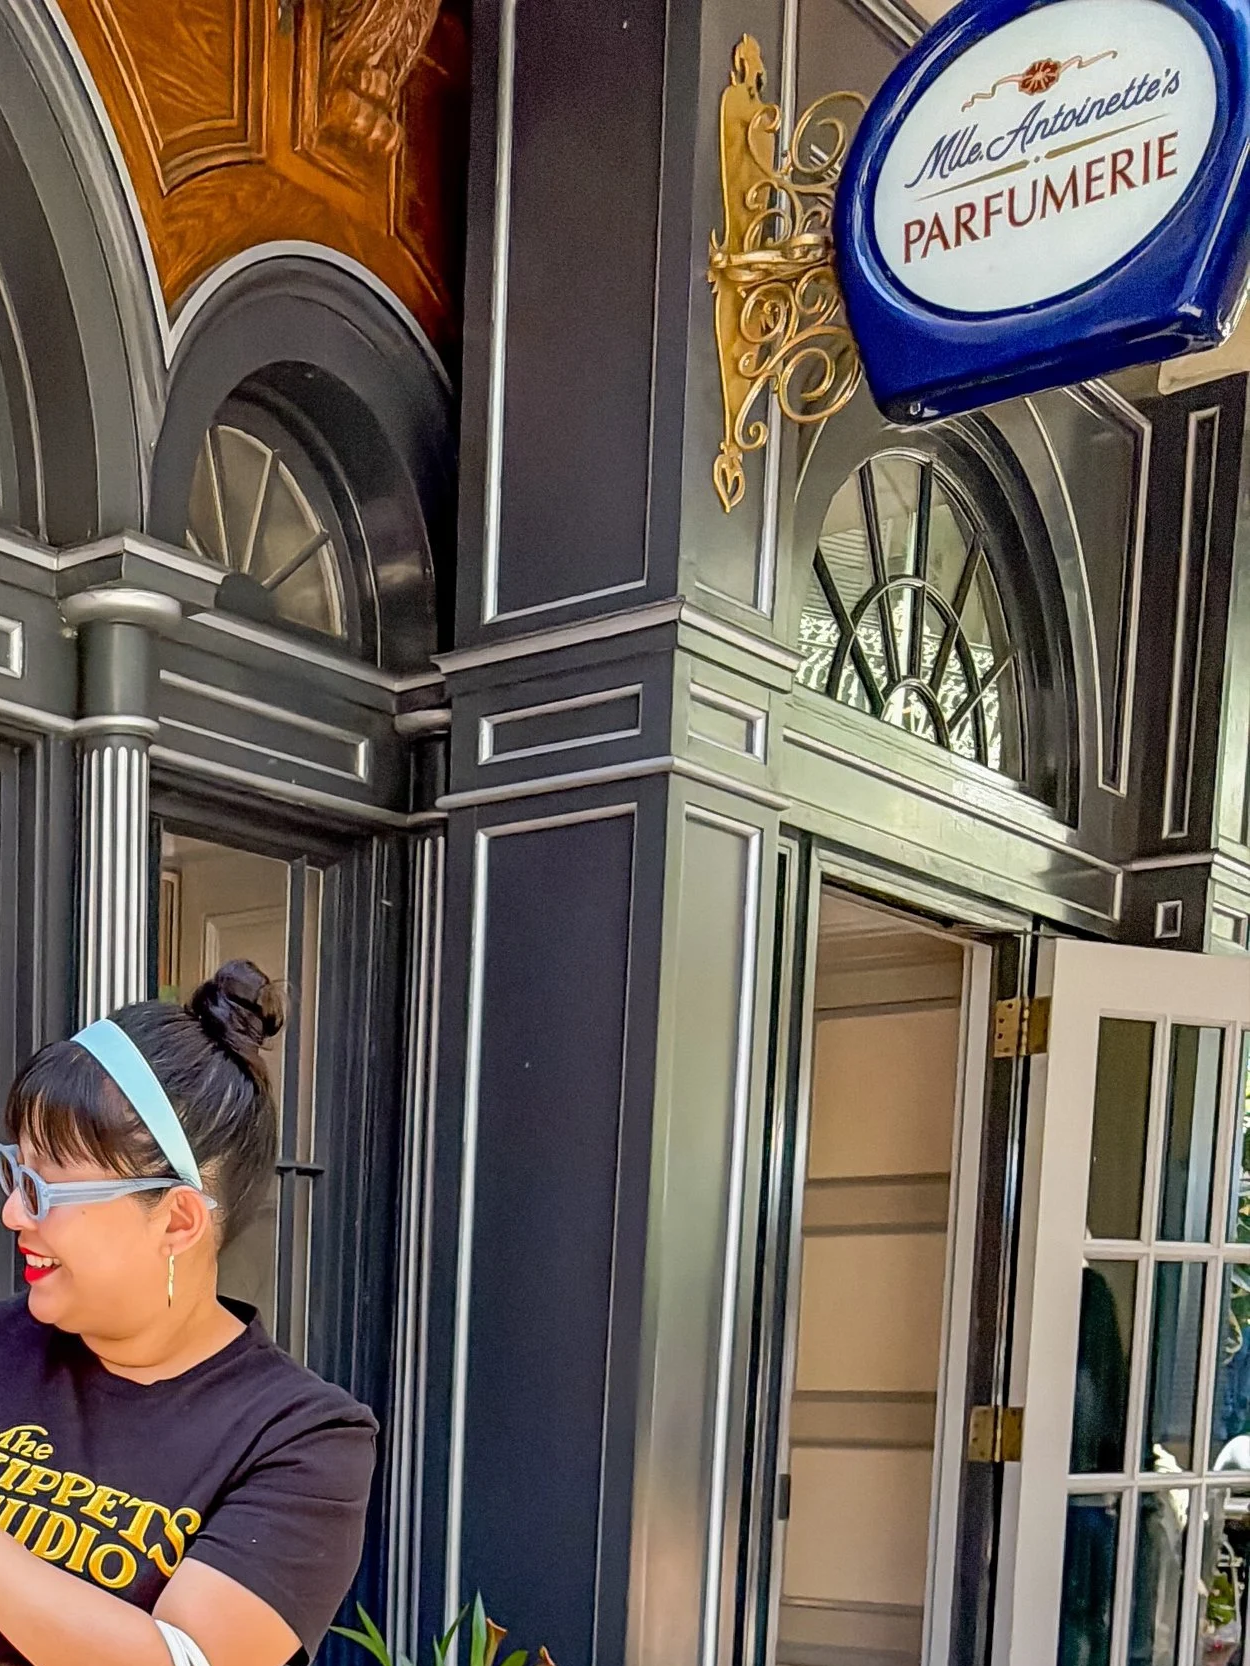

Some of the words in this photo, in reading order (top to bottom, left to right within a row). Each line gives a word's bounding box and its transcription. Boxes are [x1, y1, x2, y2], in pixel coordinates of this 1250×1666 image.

[904, 123, 984, 188] Mlle.
[986, 68, 1181, 162] Antoinette's
[902, 130, 1180, 264] PARFUMERIE
